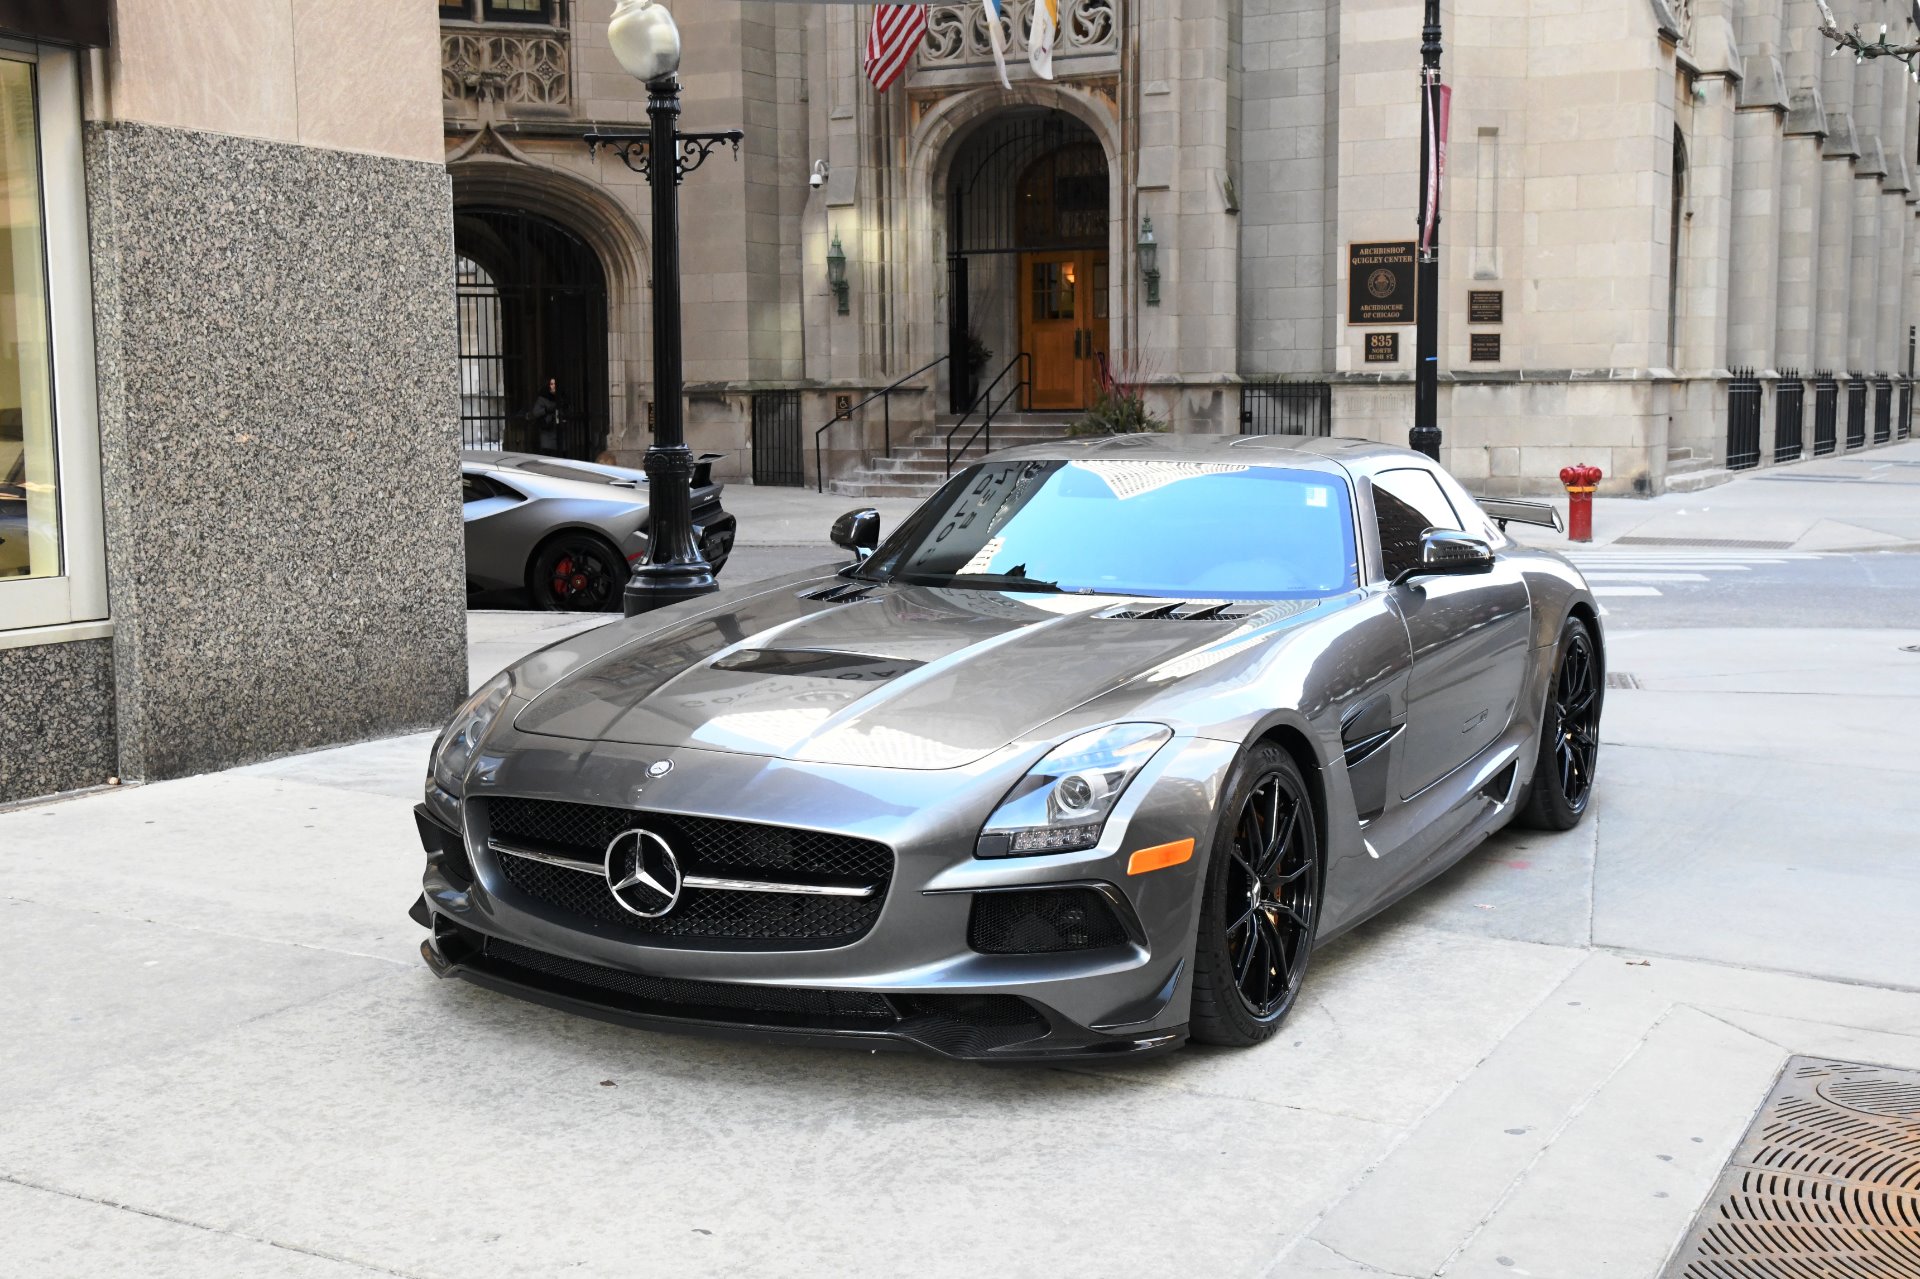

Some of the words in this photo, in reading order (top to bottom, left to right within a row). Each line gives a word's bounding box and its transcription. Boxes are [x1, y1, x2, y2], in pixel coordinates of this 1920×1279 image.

[1359, 247, 1406, 255] ARCHBISHOP
[1351, 256, 1383, 265] QUIGLEY
[1384, 255, 1412, 263] CENTER
[1371, 335, 1392, 347] 835
